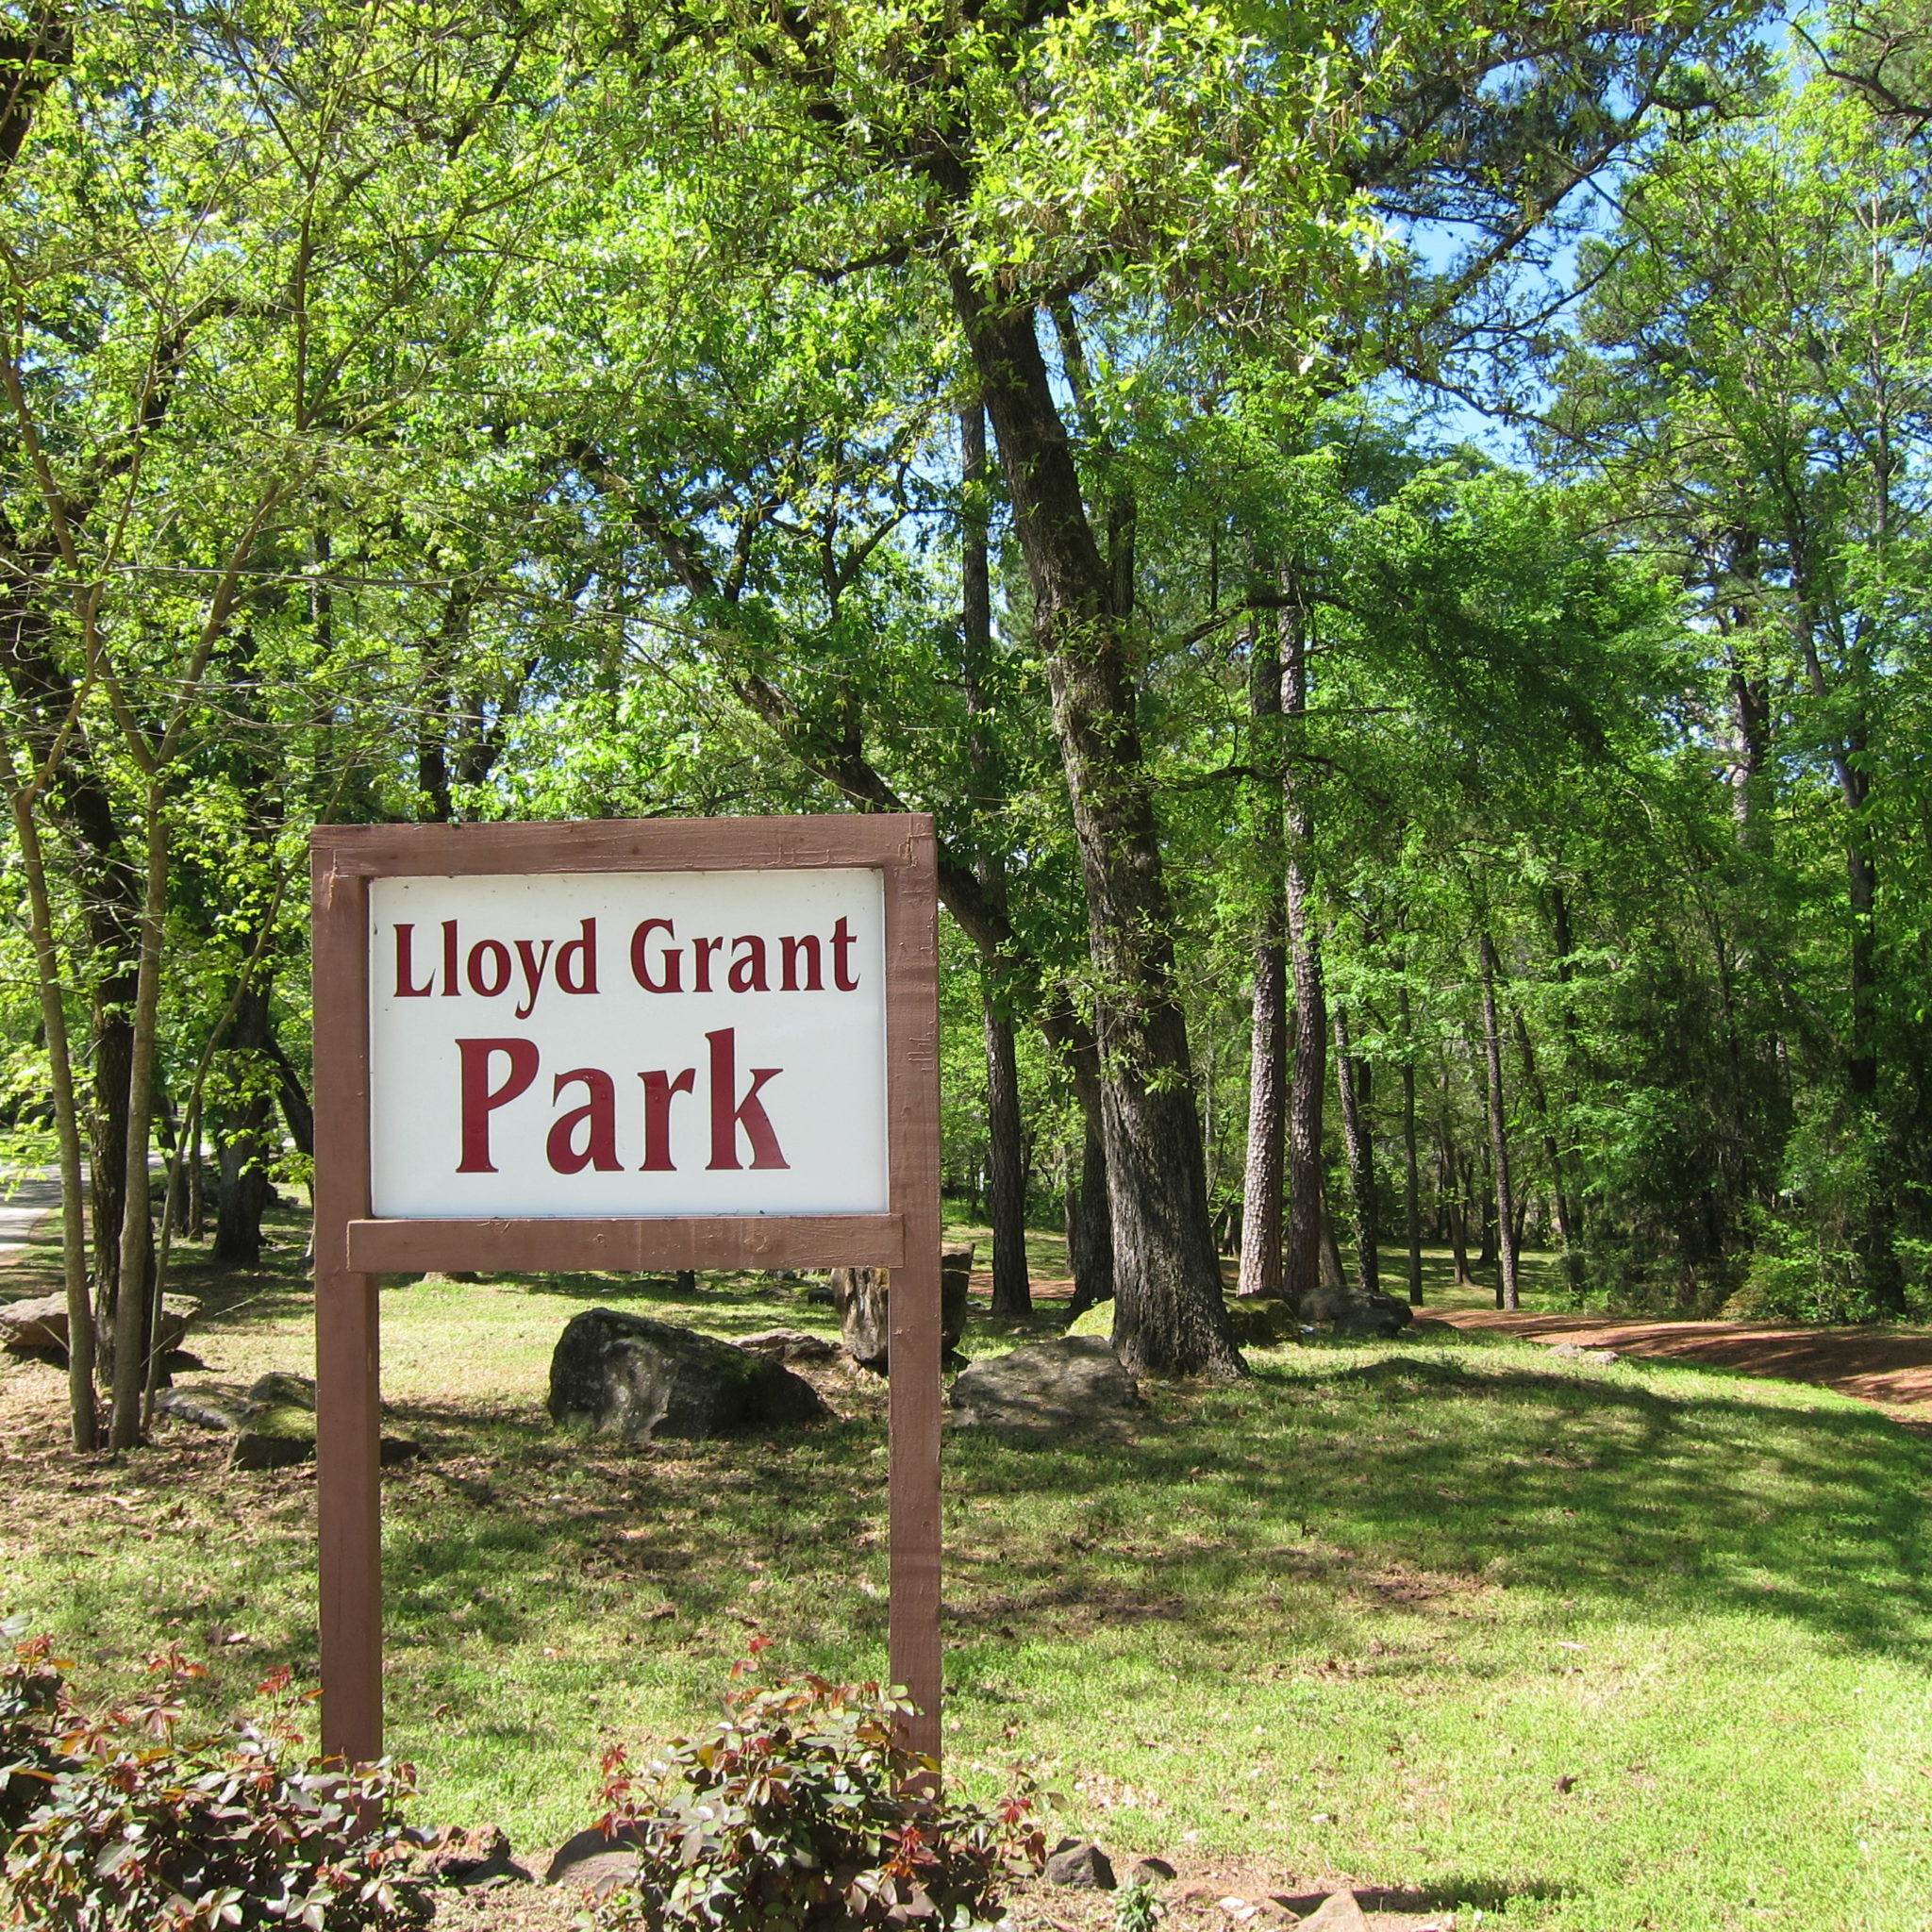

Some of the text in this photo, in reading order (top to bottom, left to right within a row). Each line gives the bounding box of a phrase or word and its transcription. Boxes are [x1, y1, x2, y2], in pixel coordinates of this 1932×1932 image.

[392, 916, 860, 1020] Lloyd Grant
[455, 1027, 791, 1174] Park
